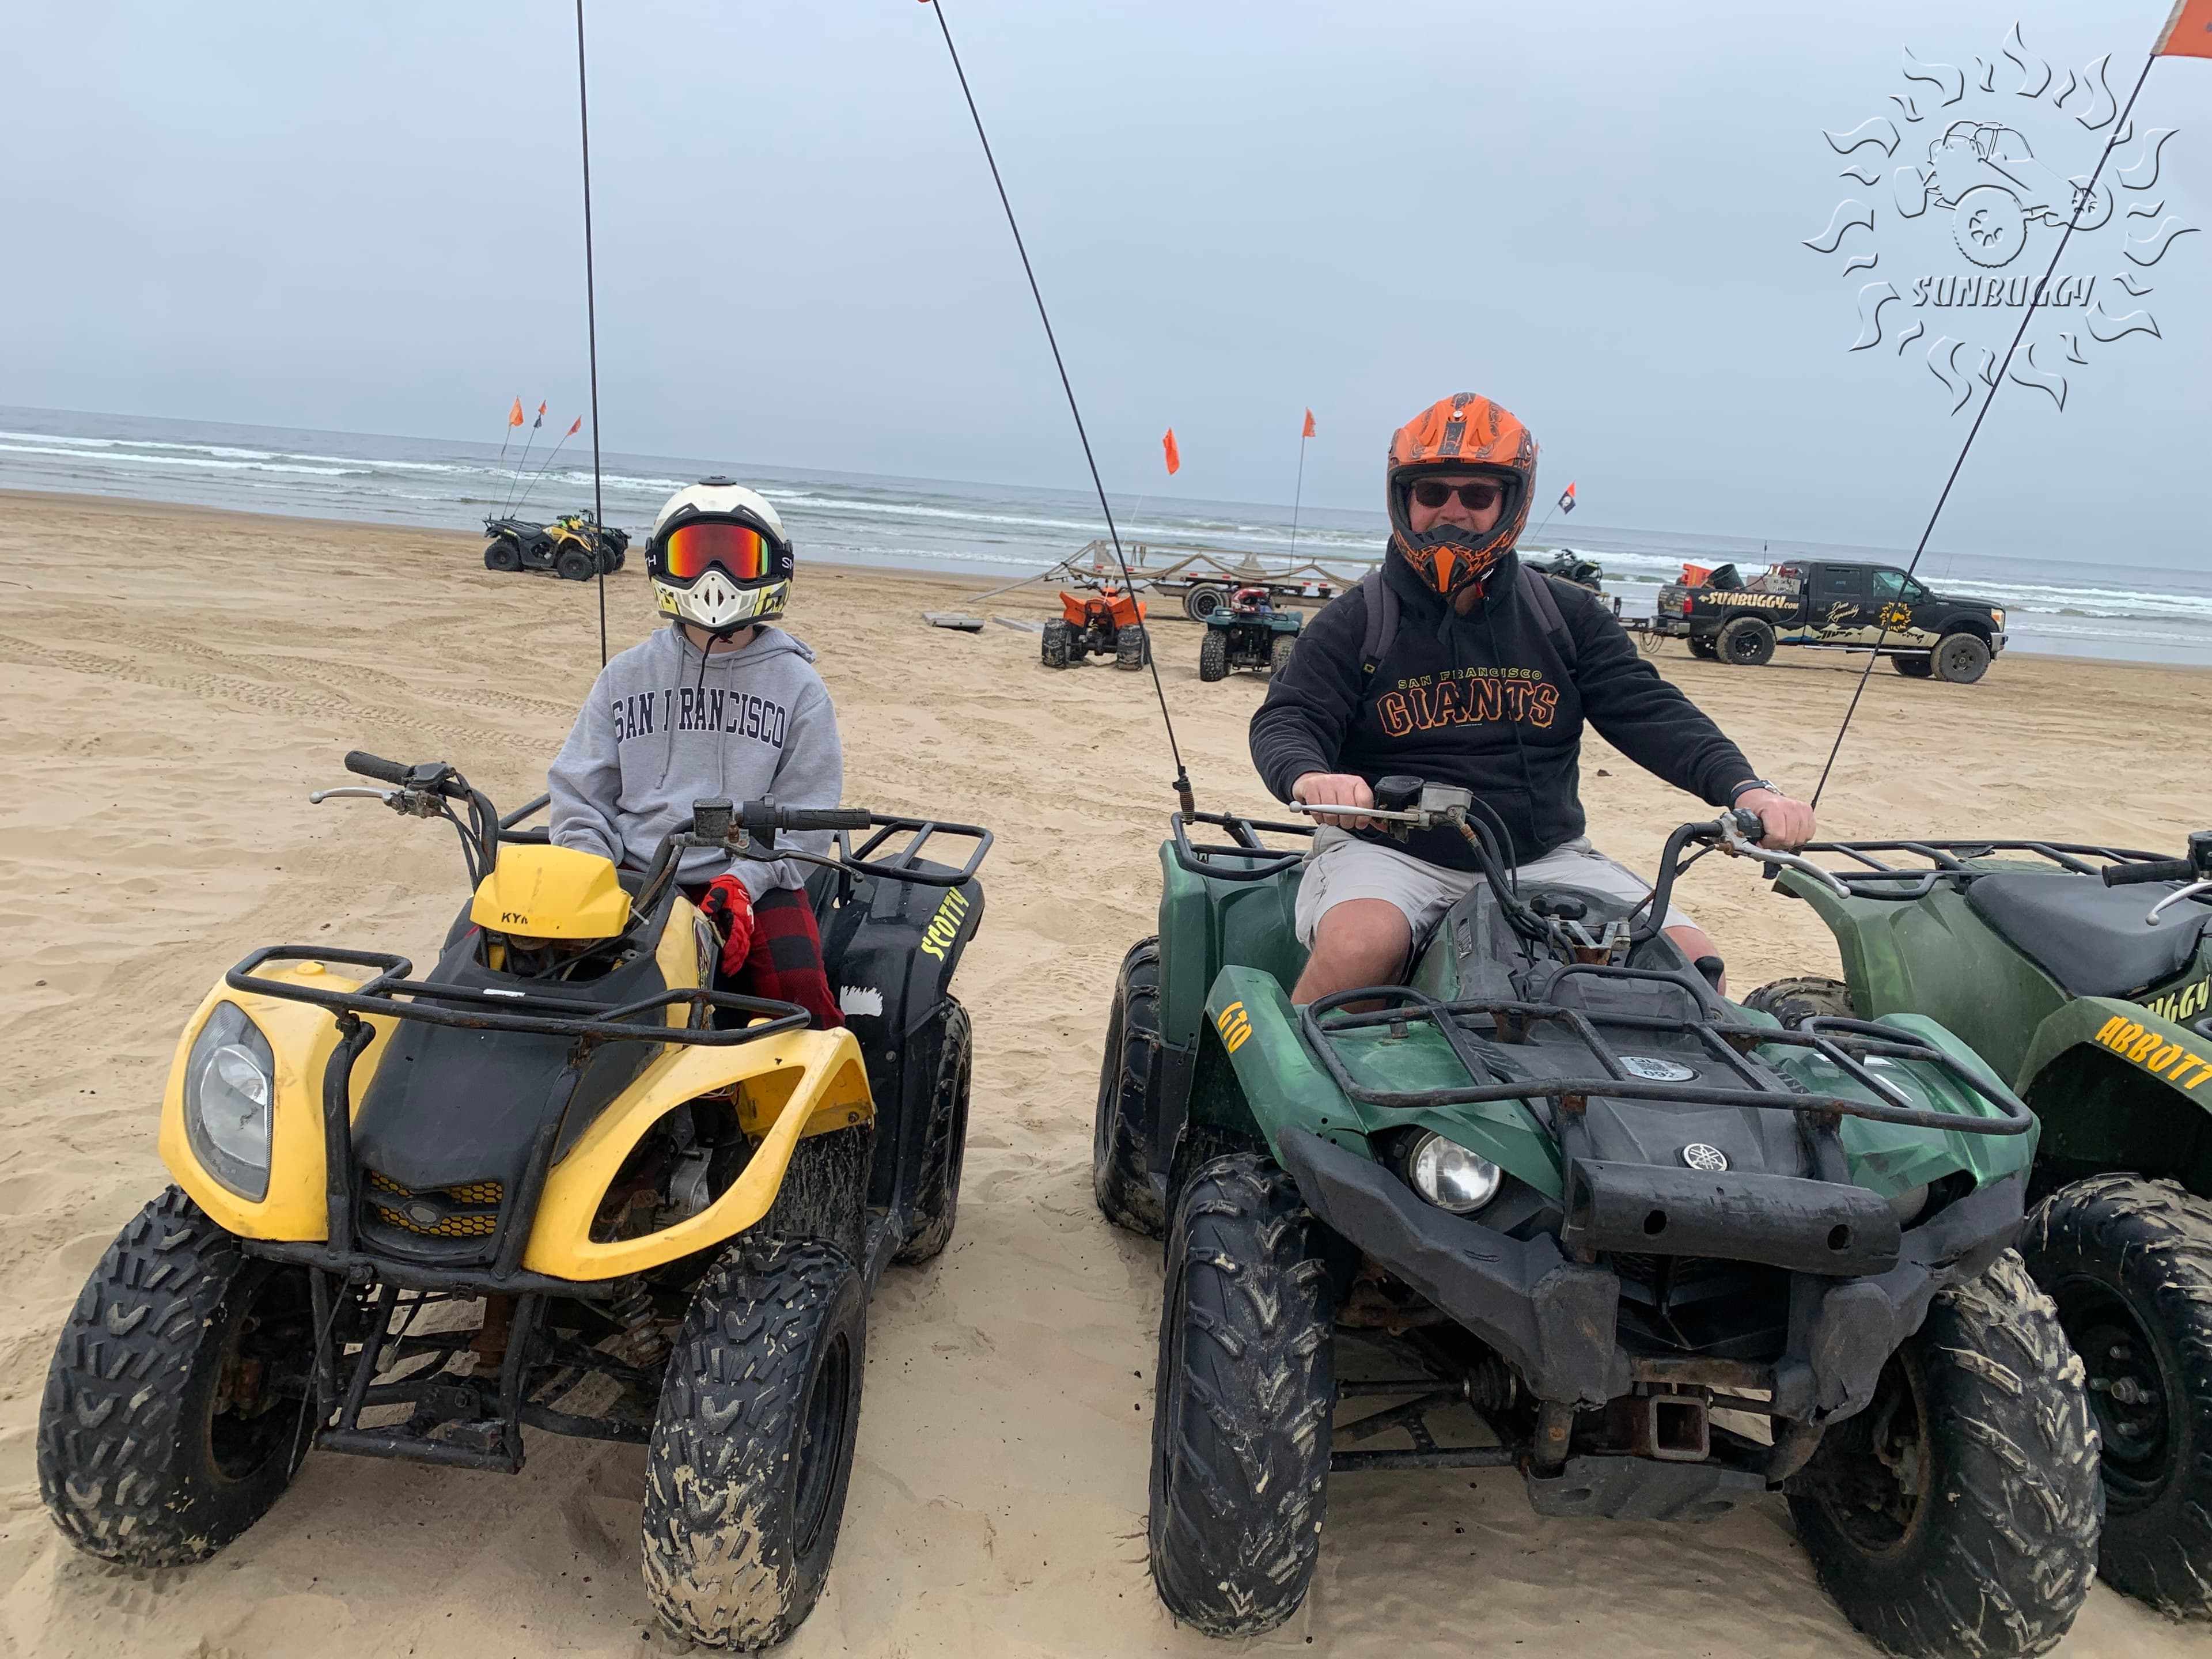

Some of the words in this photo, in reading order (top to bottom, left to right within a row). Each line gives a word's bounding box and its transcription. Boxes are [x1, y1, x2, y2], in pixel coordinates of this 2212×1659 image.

[1376, 678, 1560, 737] GIANTS
[1397, 675, 1433, 690] SAN
[1440, 666, 1543, 681] FRANCISCO
[611, 691, 656, 745] SAN
[921, 886, 970, 962] SCOTTY
[2094, 1015, 2211, 1090] ABBOTT
